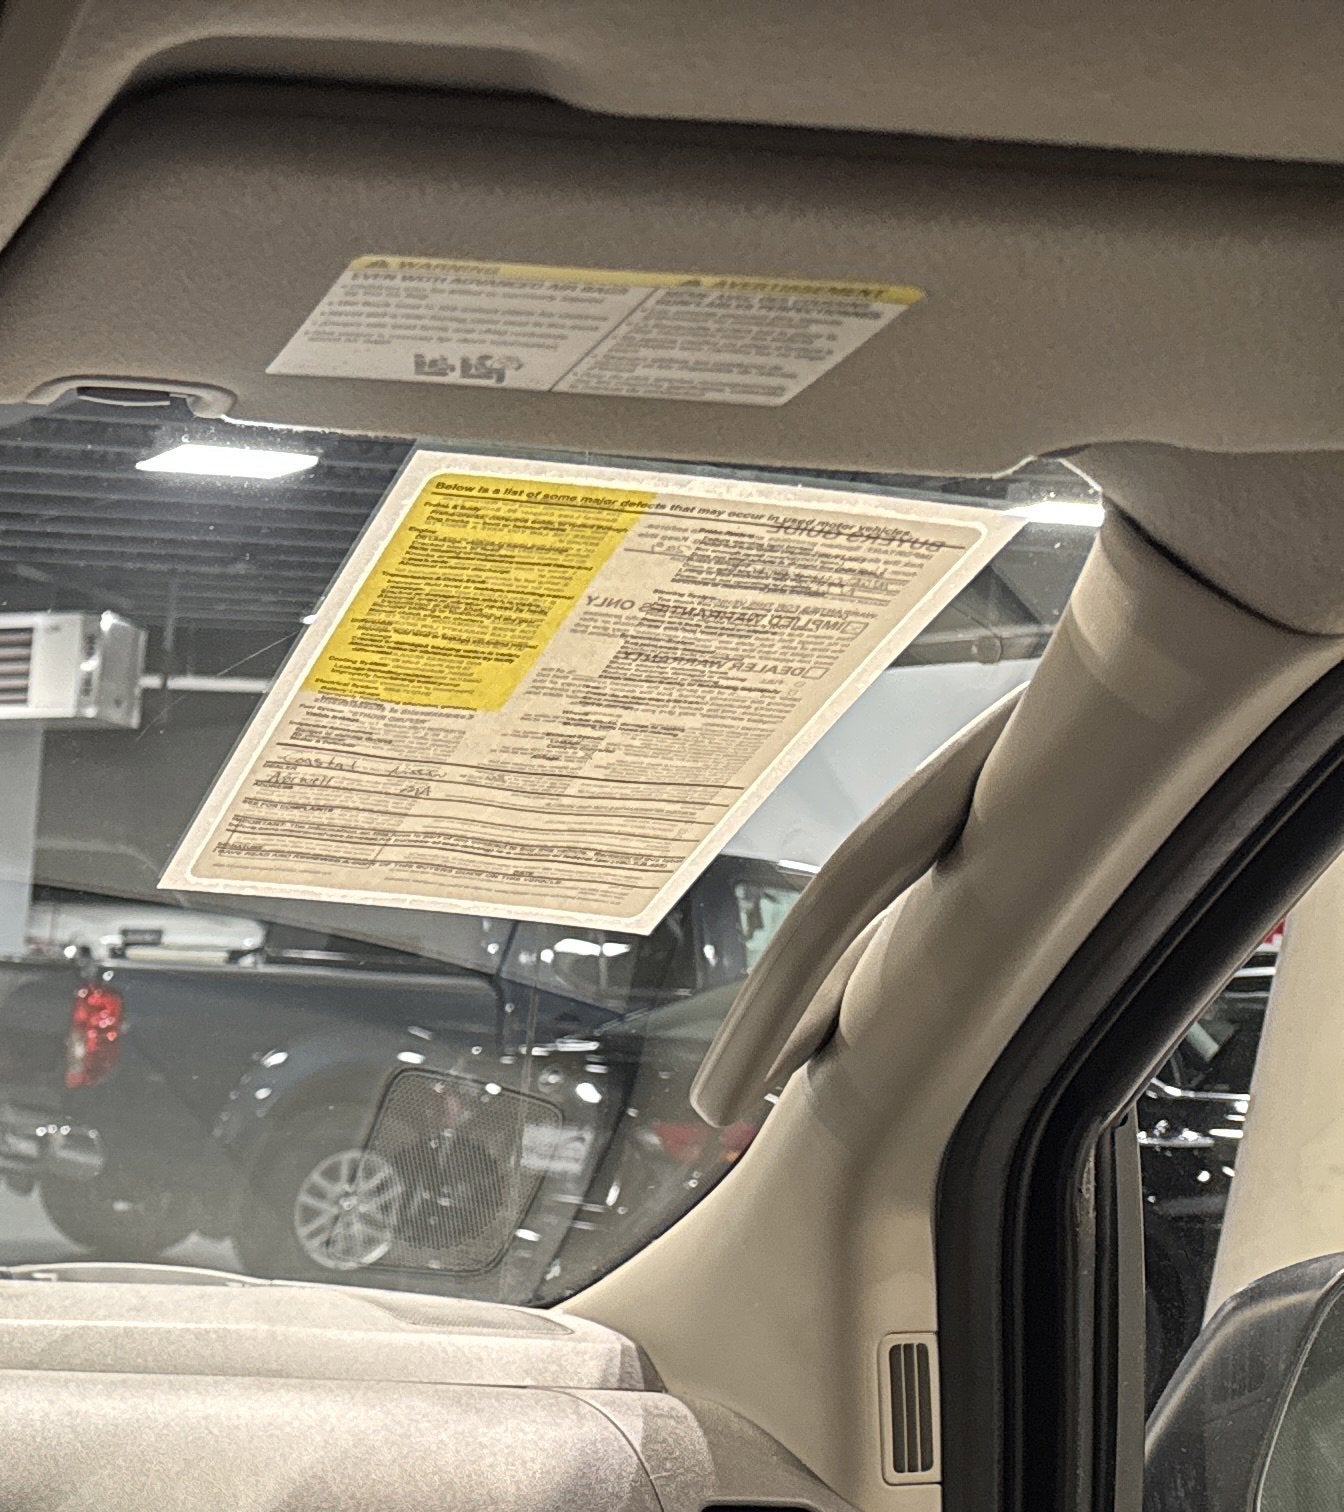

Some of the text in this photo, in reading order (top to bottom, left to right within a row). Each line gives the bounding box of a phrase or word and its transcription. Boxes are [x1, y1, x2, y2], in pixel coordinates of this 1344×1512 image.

[434, 481, 475, 493] Below
[503, 487, 525, 498] list
[526, 490, 542, 499] of
[543, 493, 578, 502] some
[579, 495, 619, 507] major
[620, 498, 666, 511] defects
[668, 503, 697, 515] that
[698, 507, 726, 519] may
[727, 510, 766, 521] occur
[767, 513, 781, 523] in
